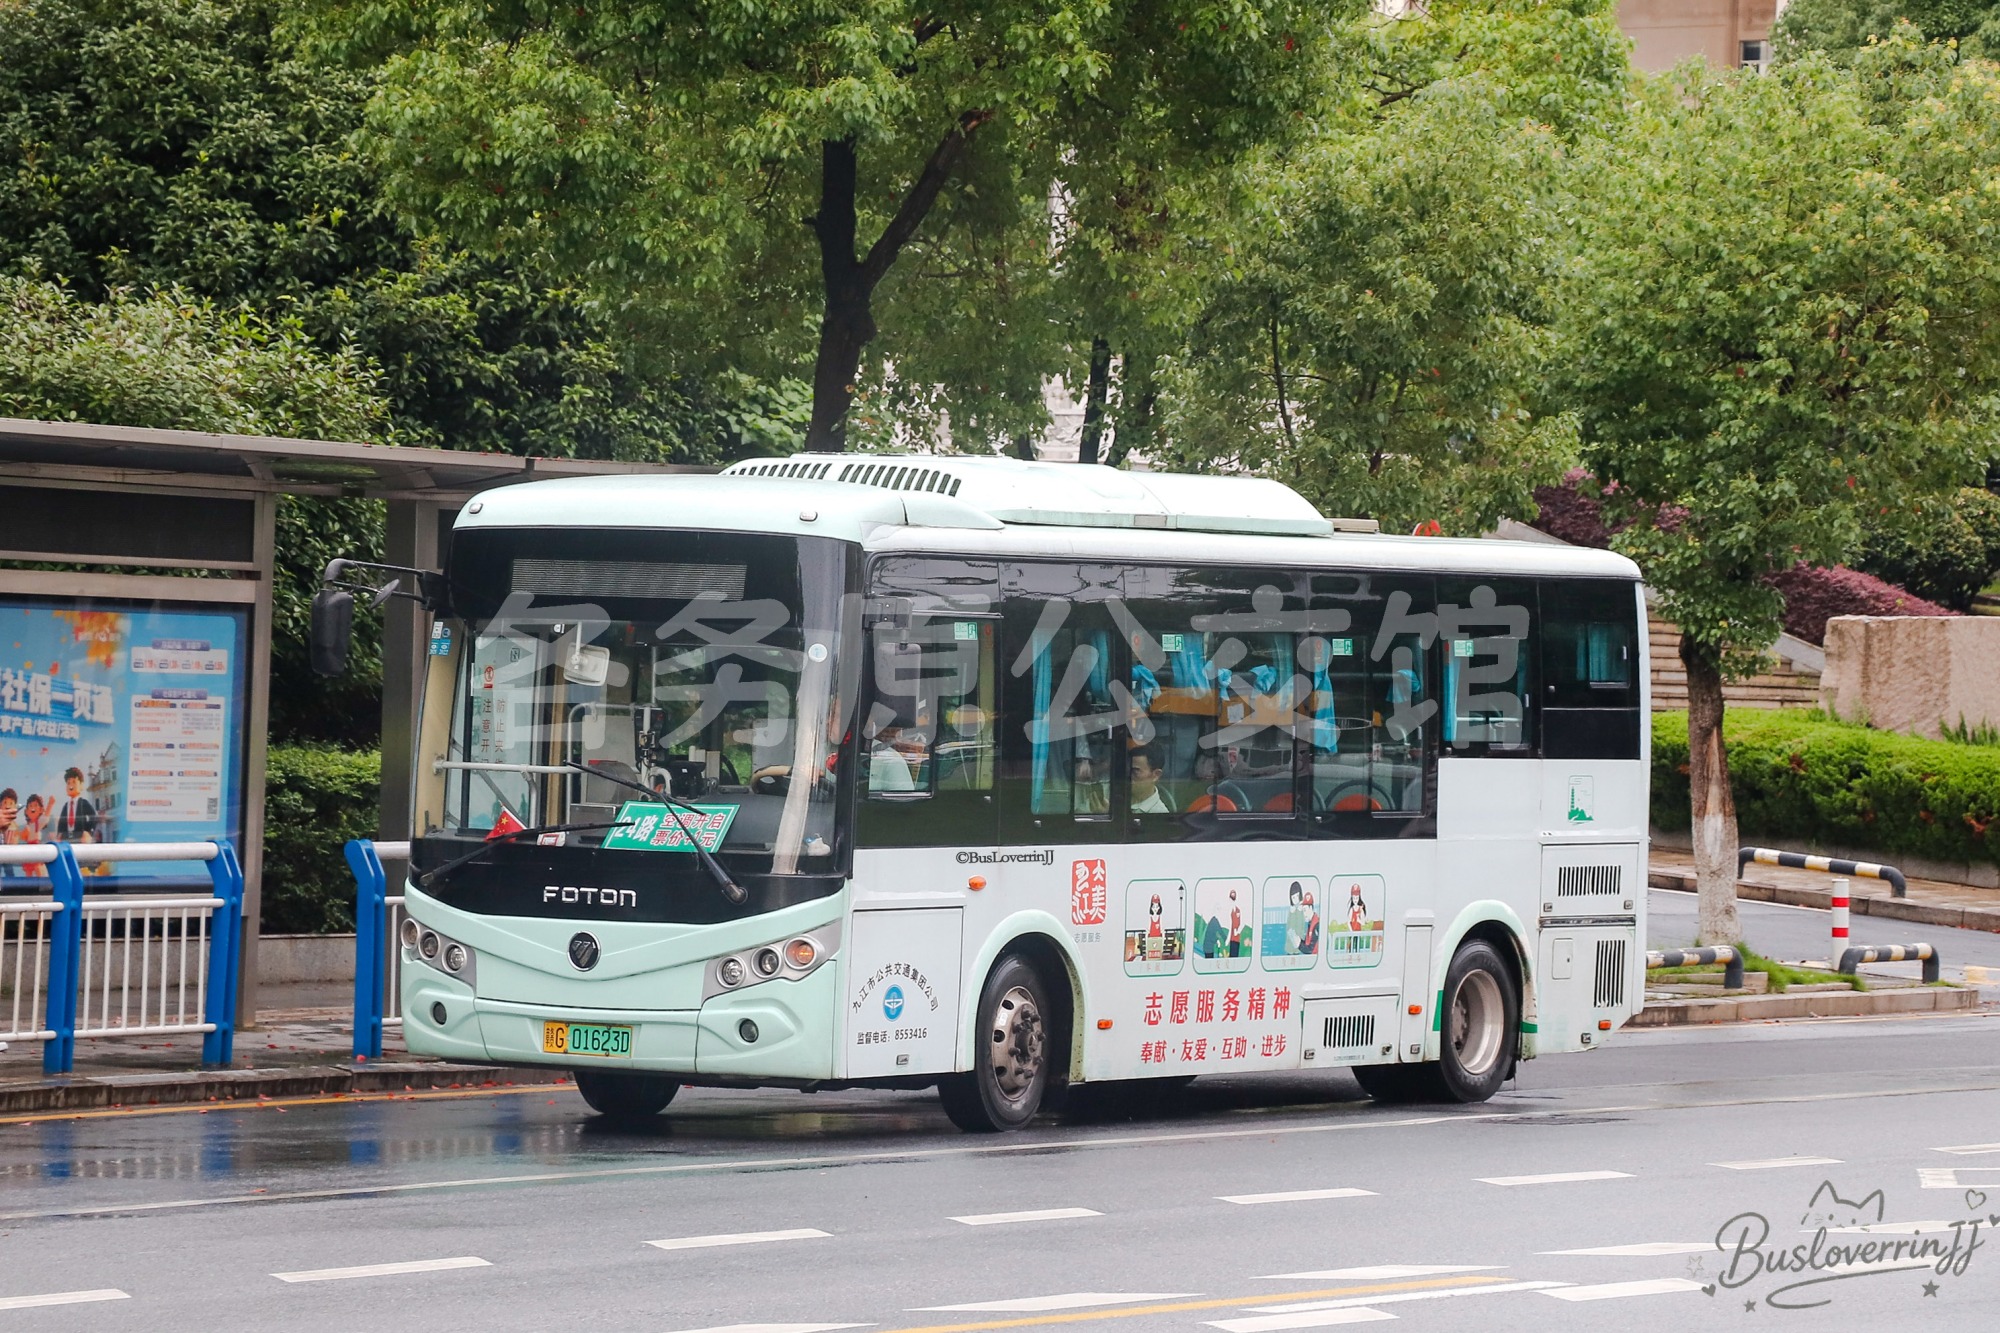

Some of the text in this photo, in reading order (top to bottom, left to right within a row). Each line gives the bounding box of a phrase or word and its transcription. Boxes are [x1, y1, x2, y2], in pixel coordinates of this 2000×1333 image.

[613, 815, 659, 841] 24路
[660, 812, 727, 829] 空调开启
[543, 886, 637, 908] FOTON
[852, 962, 939, 1013] 九江市公共交通集团公司
[1143, 986, 1292, 1026] 志愿服务精神
